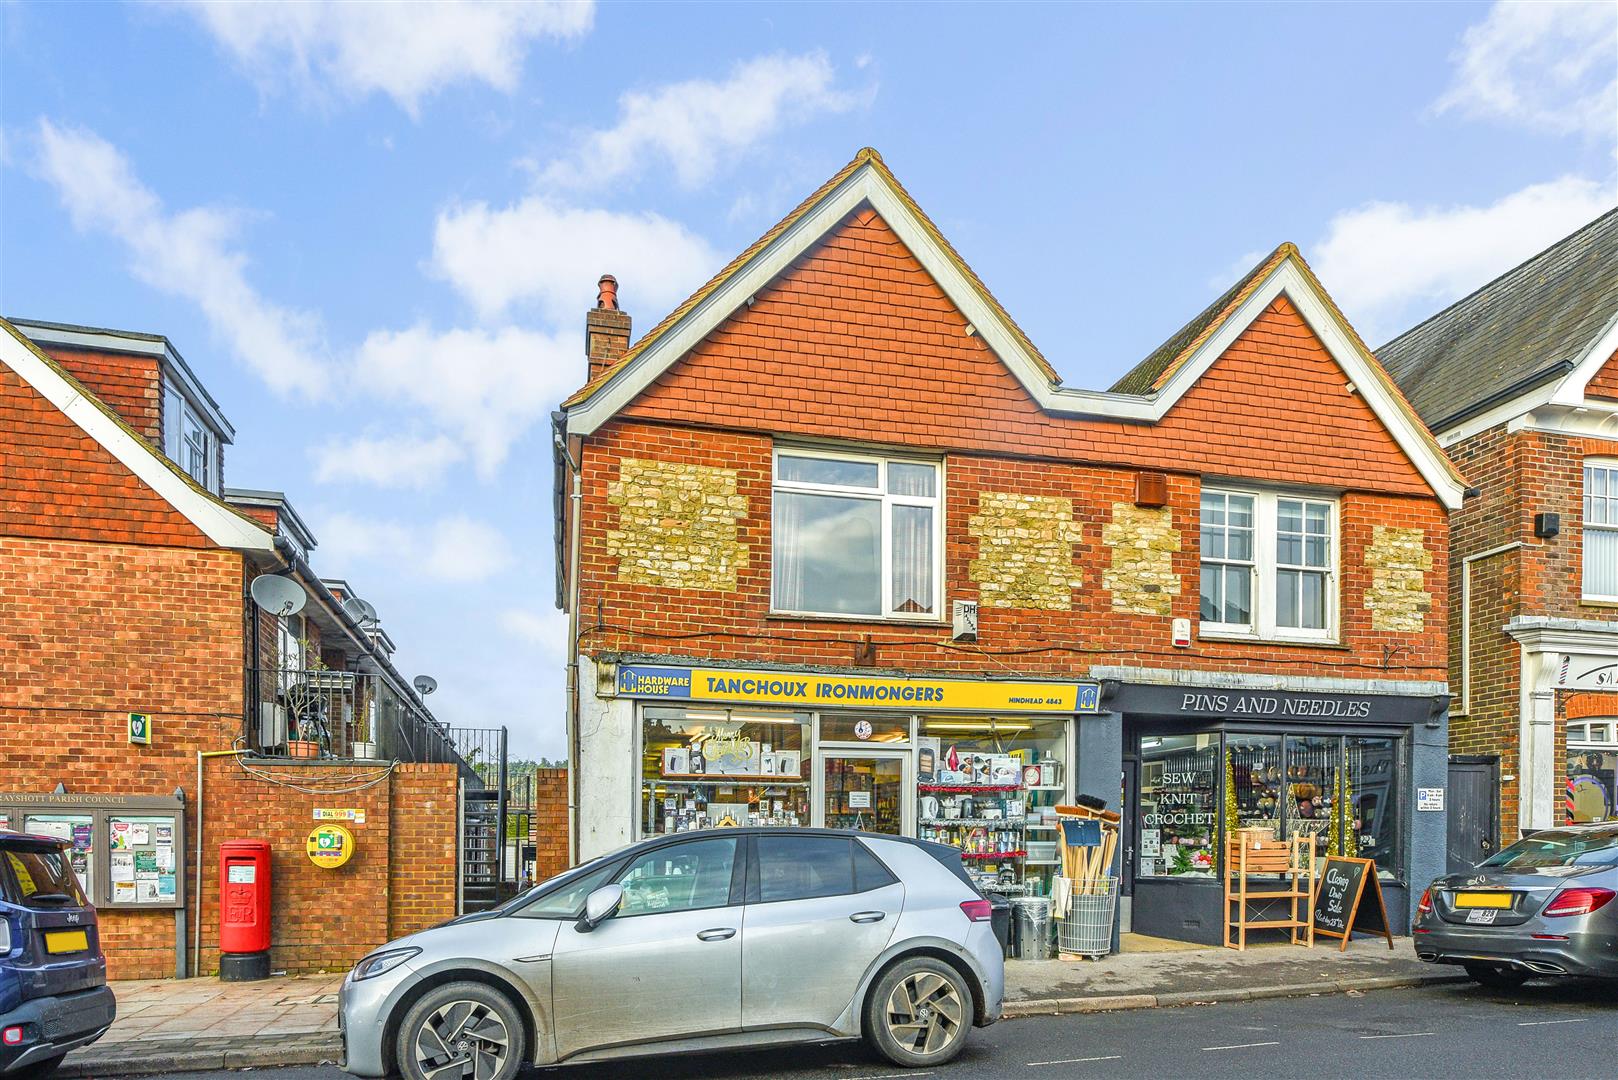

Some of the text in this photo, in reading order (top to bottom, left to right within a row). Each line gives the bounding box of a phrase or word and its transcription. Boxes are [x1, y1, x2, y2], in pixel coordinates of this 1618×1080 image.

[963, 604, 976, 614] DH
[637, 675, 690, 687] HARDWARE
[1596, 670, 1618, 686] SA
[637, 684, 669, 695] HOUSE
[706, 677, 944, 702] TANCHOUX IRONMONGERS
[1008, 697, 1044, 705] HINDHEAD
[1180, 693, 1371, 718] PINS AND NEEDLES
[1162, 772, 1197, 784] SEW
[49, 796, 83, 804] PARISH
[85, 796, 127, 804] COUNCIL
[1160, 793, 1198, 805] KNIT
[1144, 813, 1215, 825] CROCHET
[1326, 868, 1349, 892] Closing
[1327, 899, 1343, 914] Sale
[66, 913, 80, 924] Jeep
